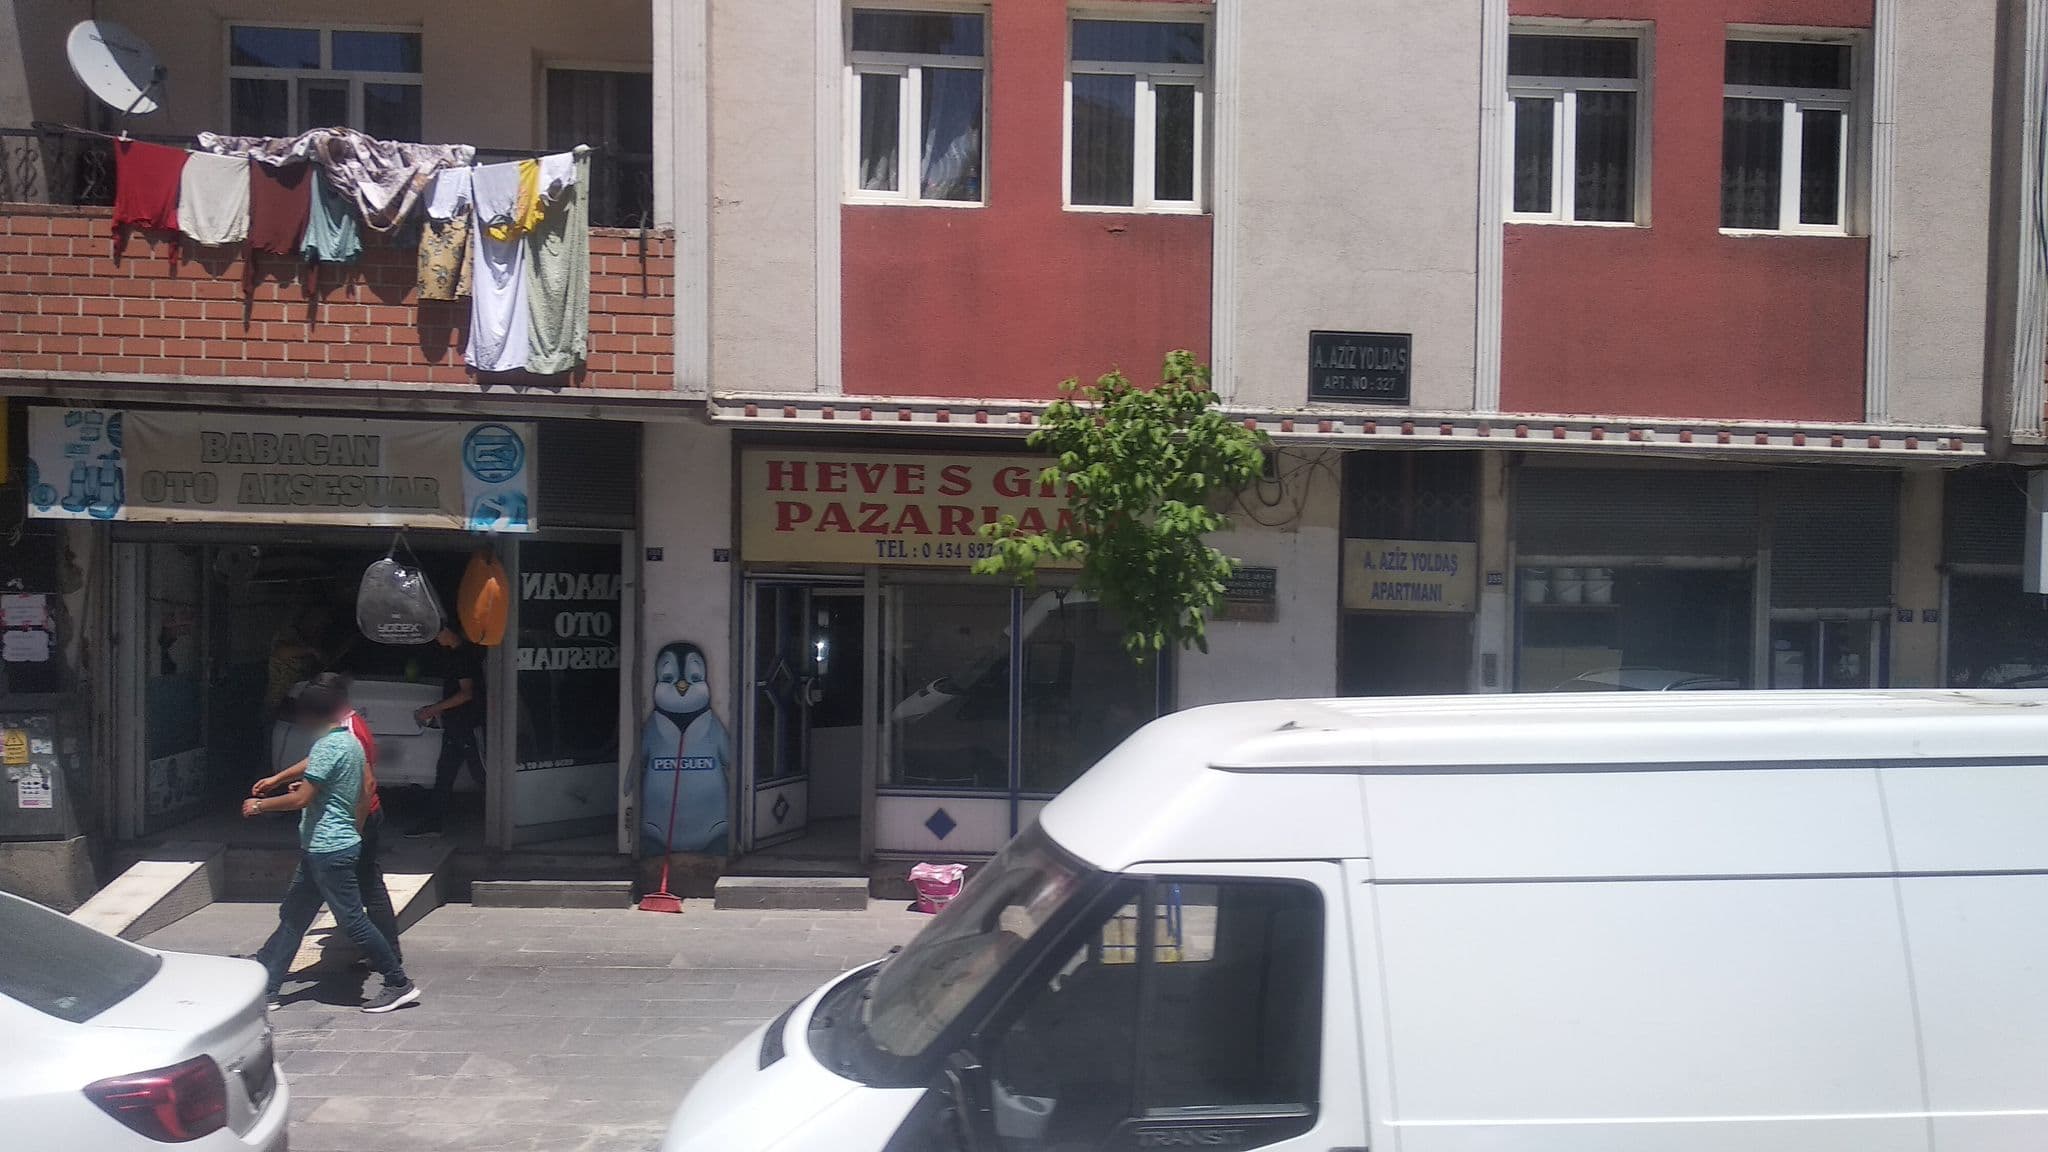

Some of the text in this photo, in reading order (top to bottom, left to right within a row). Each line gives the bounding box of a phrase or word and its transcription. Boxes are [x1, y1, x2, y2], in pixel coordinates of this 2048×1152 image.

[1359, 346, 1407, 375] YOLDAŞ
[201, 431, 381, 467] BABACAN
[141, 470, 440, 509] OTO AKSESUAR
[922, 542, 930, 559] 0
[936, 542, 962, 559] 434
[1411, 553, 1458, 576] YOLDAŞ
[653, 758, 714, 769] PENGUEN
